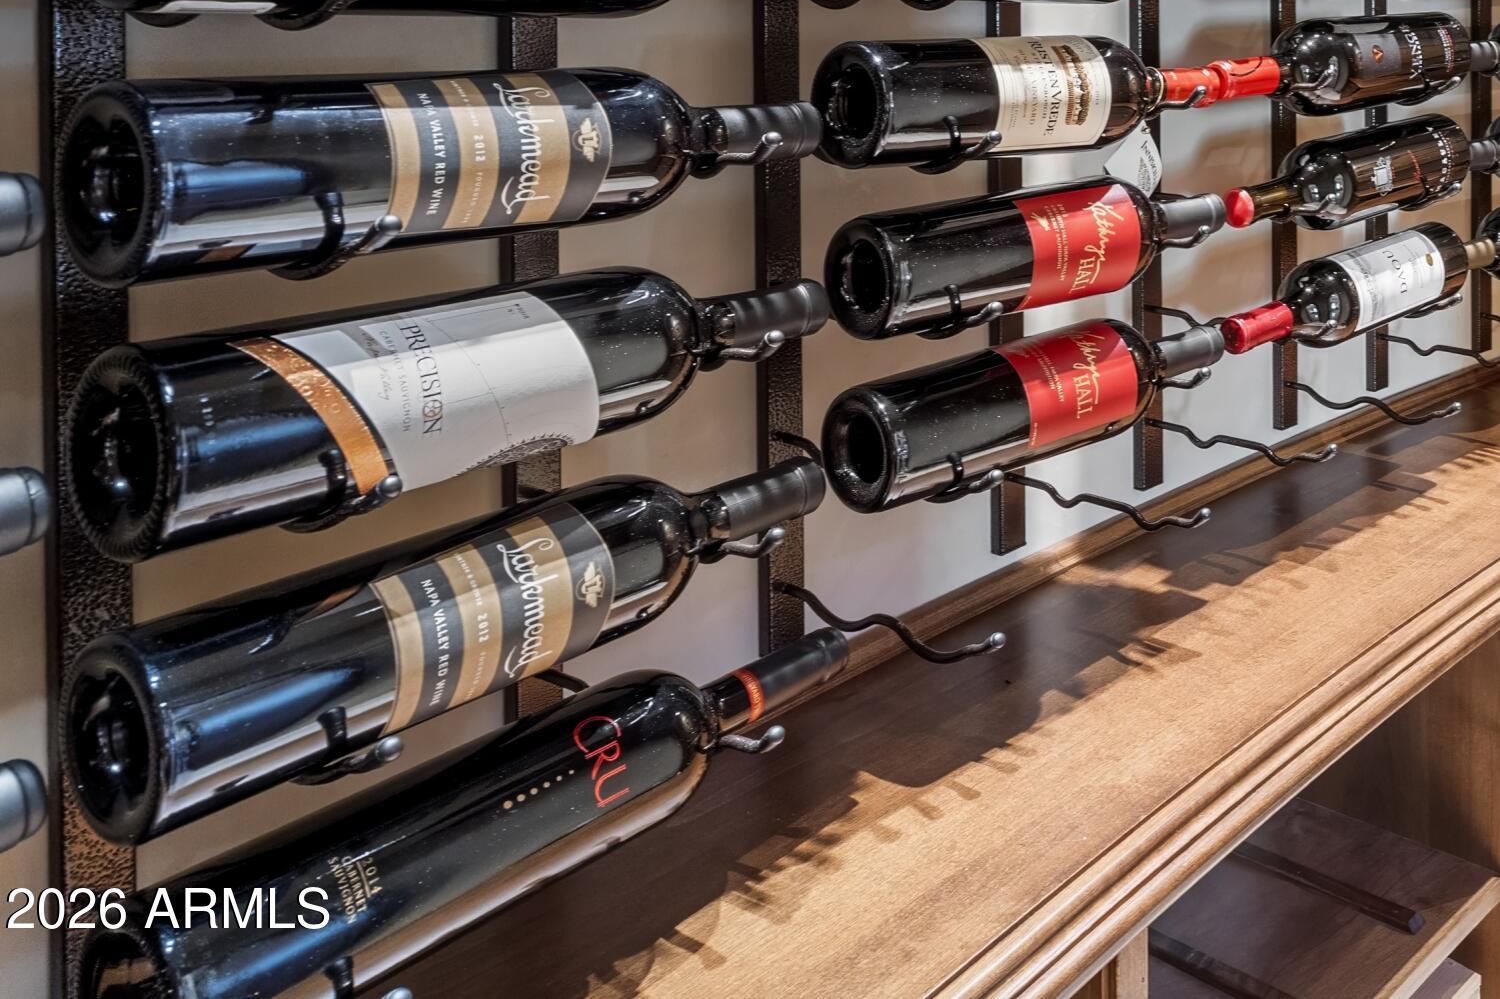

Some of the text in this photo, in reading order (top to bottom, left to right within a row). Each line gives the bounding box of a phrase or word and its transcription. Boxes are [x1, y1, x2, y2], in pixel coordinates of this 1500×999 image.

[1028, 40, 1053, 67] RUST
[1047, 69, 1059, 89] EN
[416, 92, 446, 216] NAPA VALLEY RED WINE
[473, 134, 486, 162] 2012
[492, 82, 555, 215] Larkmead
[1069, 256, 1096, 294] HALL
[399, 324, 444, 435] PRECISION
[399, 373, 412, 433] SAUVIGNON
[1073, 373, 1094, 419] HALL
[476, 612, 491, 644] 2012
[496, 537, 559, 679] Larkmead
[419, 578, 450, 707] NAPA VALLEY RED WINE
[573, 715, 630, 807] CRU
[327, 855, 358, 925] SAUVIGNON
[340, 855, 368, 912] CABERNET
[363, 856, 383, 896] 2014
